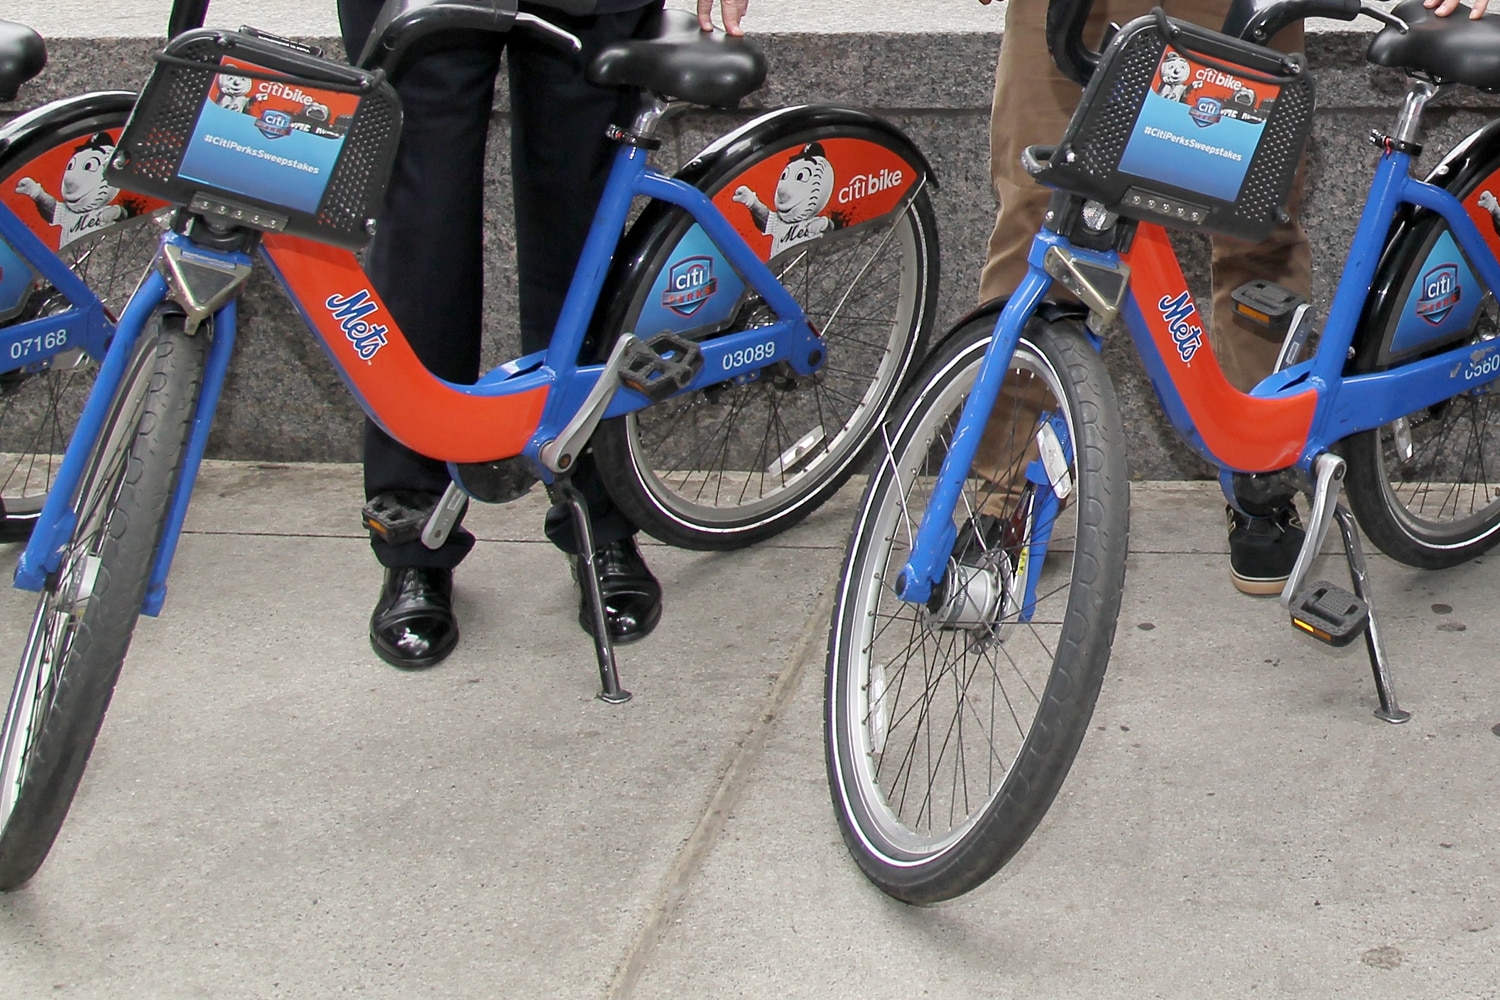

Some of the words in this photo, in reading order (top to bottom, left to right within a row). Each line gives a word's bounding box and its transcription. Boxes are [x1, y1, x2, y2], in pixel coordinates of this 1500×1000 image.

[265, 114, 285, 127] citi
[1198, 102, 1216, 114] citi
[204, 134, 320, 175] #CitiPerksSweepstakes
[1143, 125, 1243, 162] #CitiPerksSweepstakes
[676, 264, 704, 290] citi
[1428, 273, 1450, 298] citi
[325, 288, 389, 361] Mets
[1158, 290, 1203, 363] Mets
[10, 328, 67, 360] 07168
[722, 341, 775, 370] 03089
